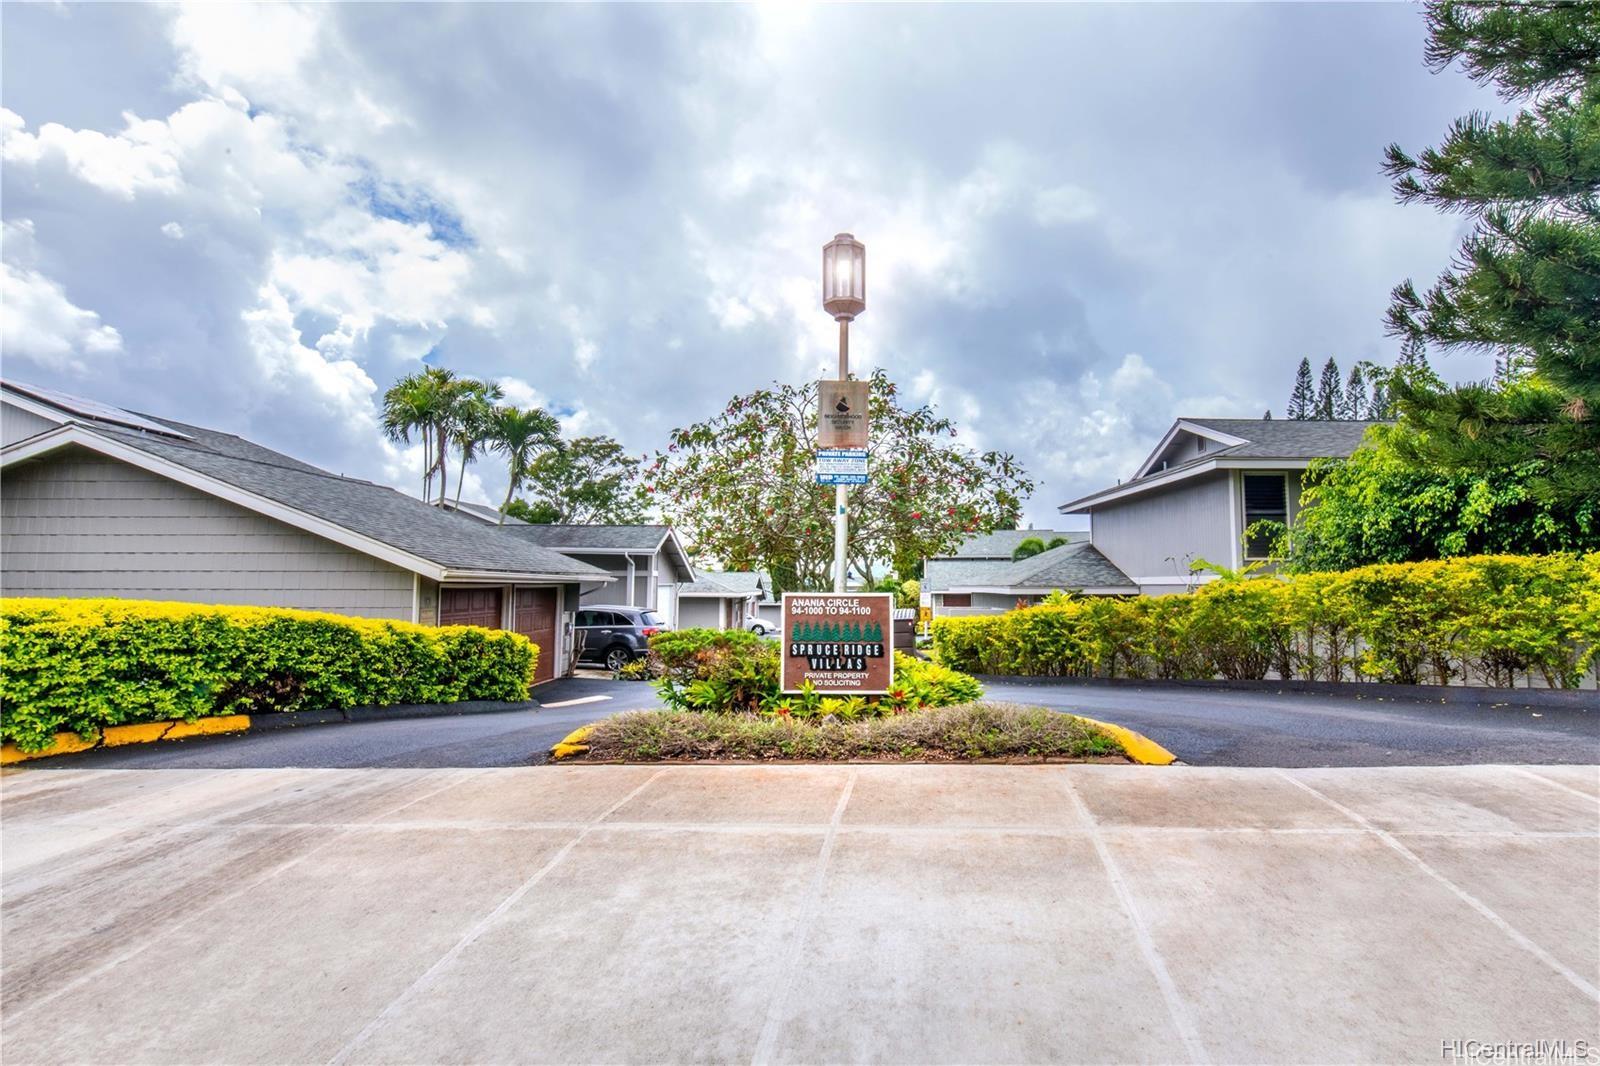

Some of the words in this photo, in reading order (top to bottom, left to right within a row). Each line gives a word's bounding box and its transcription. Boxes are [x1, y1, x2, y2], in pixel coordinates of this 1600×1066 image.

[792, 644, 838, 655] SPRUCE
[844, 644, 879, 655] RIDGE
[812, 658, 862, 669] VILLAS
